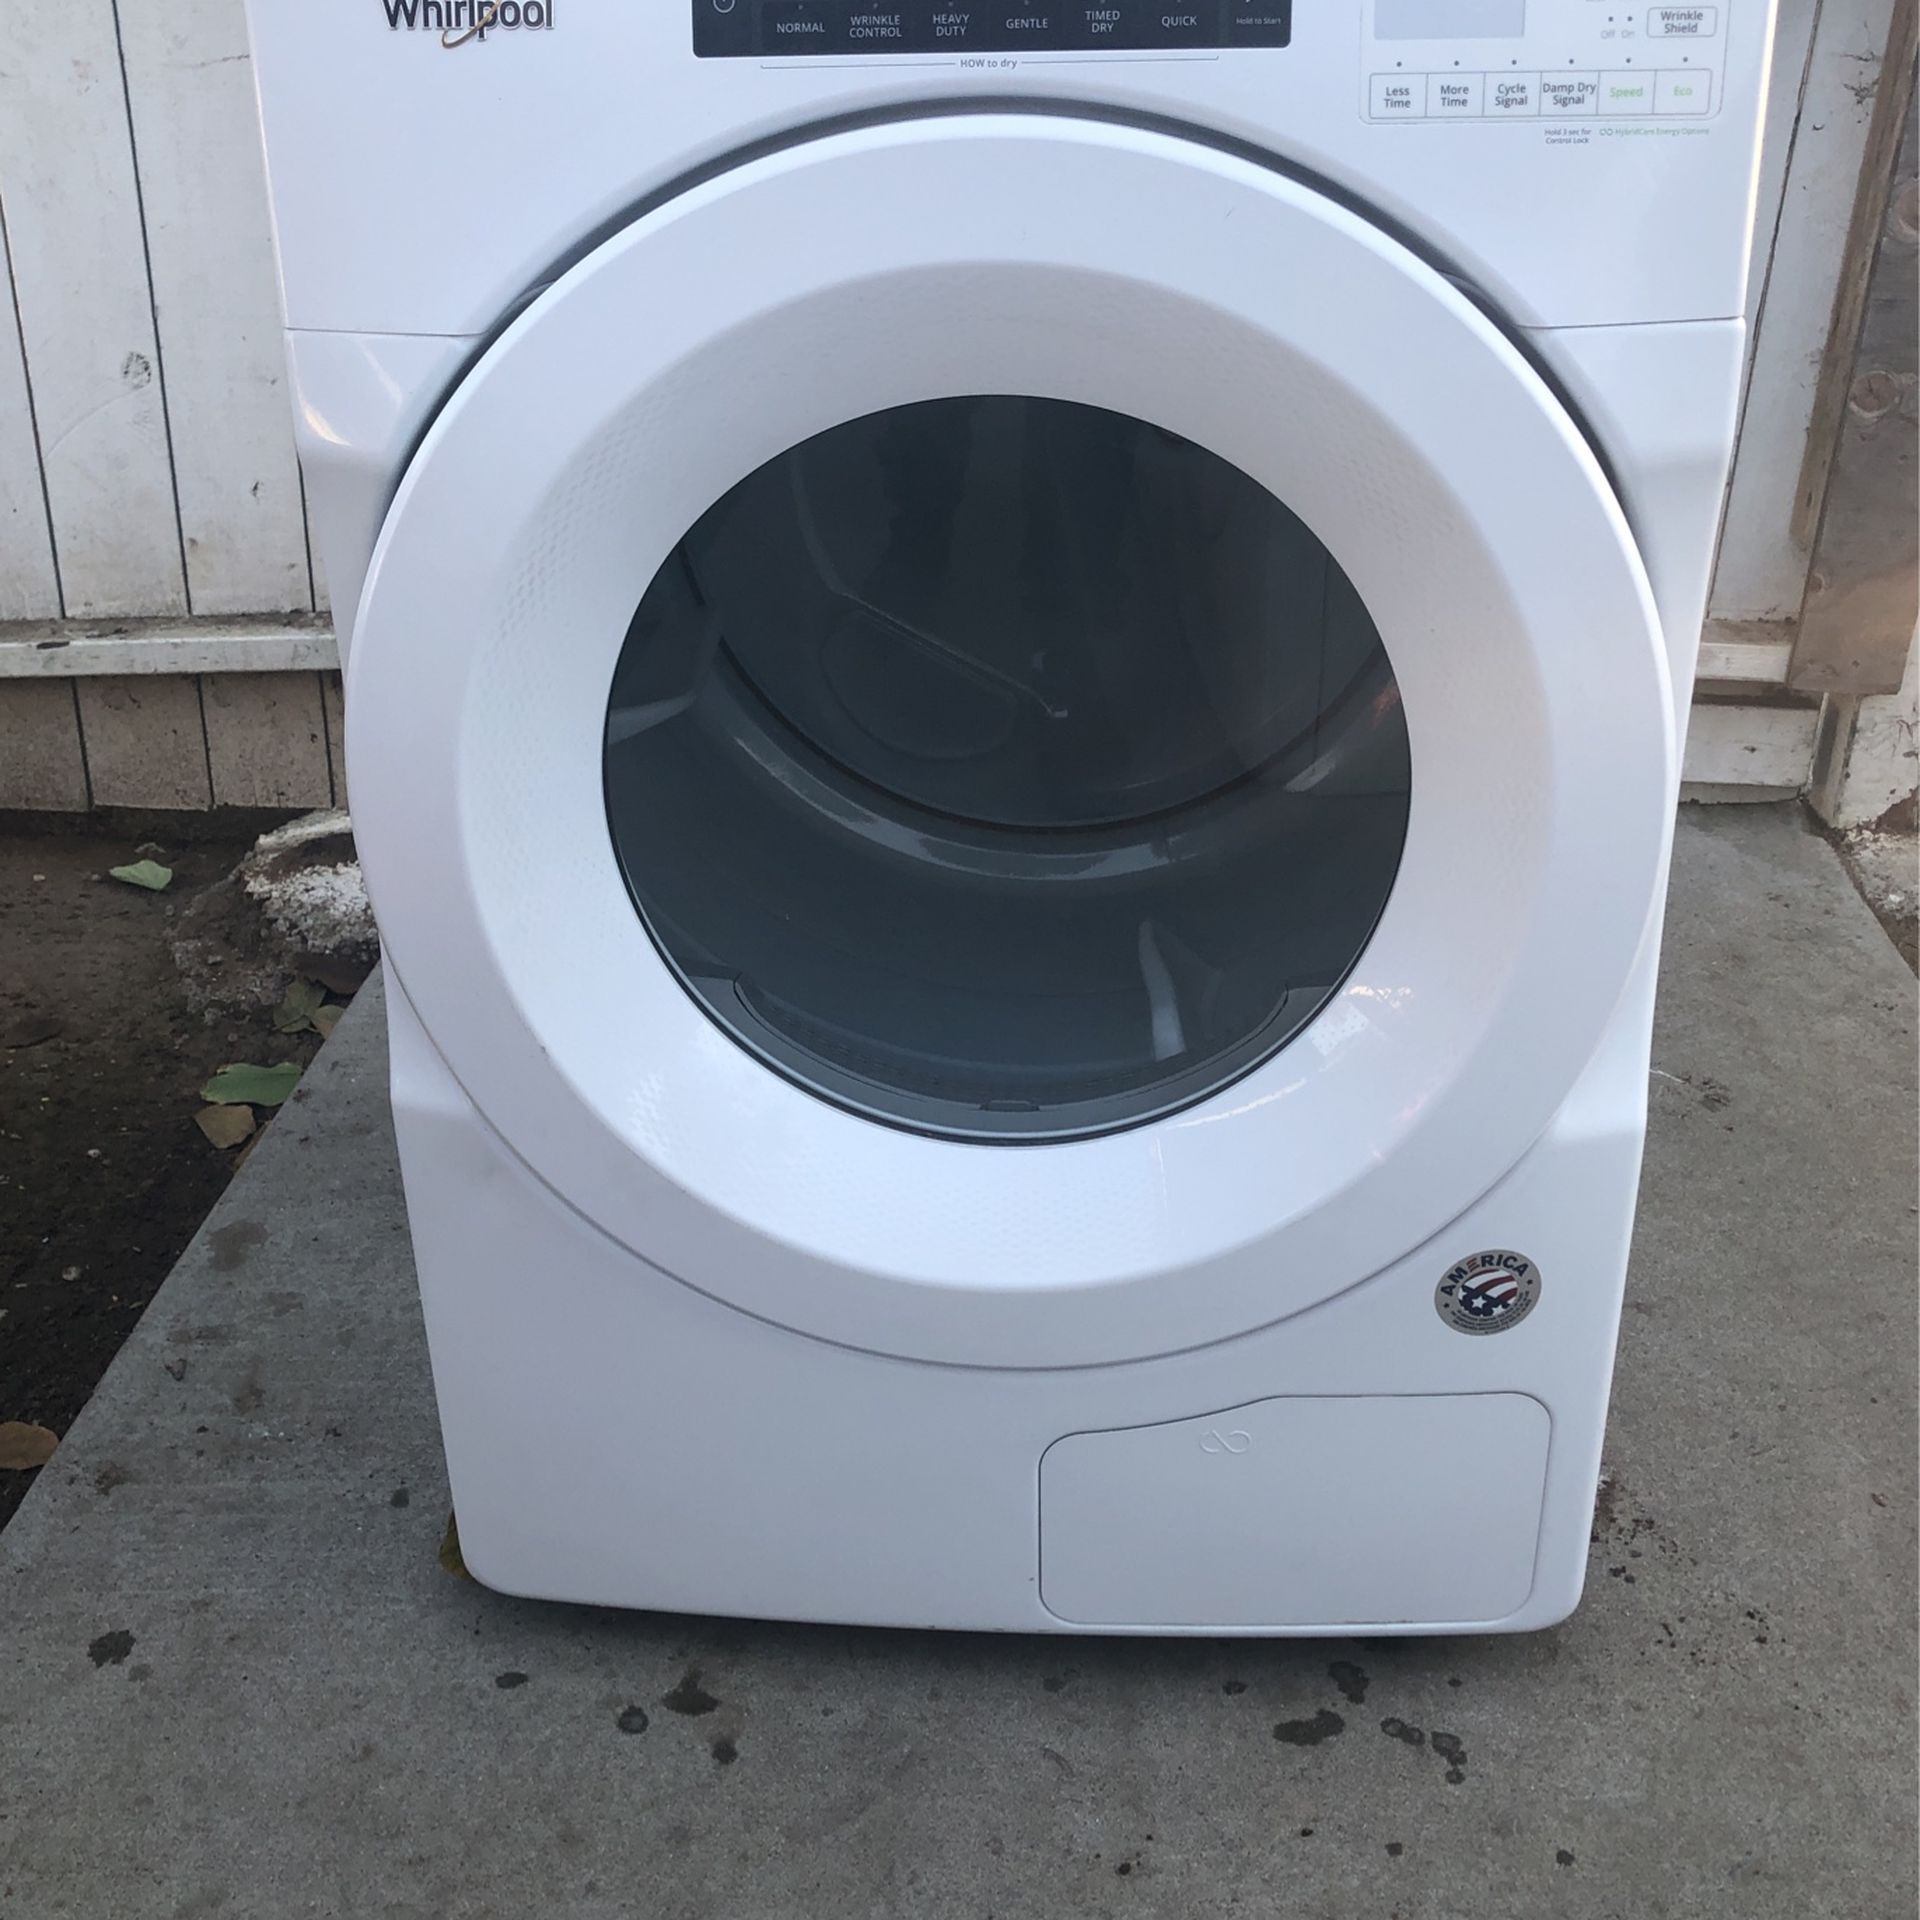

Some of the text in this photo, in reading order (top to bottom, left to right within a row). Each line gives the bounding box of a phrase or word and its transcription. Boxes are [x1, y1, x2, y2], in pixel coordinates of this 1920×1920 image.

[383, 0, 555, 41] Whirlpool
[850, 15, 901, 26] WRINKLE
[933, 14, 970, 25] HEAVY
[1085, 10, 1120, 21] TIMED
[1660, 10, 1703, 21] Wrinkle
[1006, 18, 1049, 29] GENTLE
[1161, 16, 1198, 27] QUICK
[776, 22, 825, 33] NORMAL
[850, 26, 902, 38] CONTROL
[936, 26, 967, 37] DUTY
[1091, 22, 1114, 33] DRY
[1664, 23, 1698, 34] Shield
[1600, 30, 1615, 39] Off
[1621, 30, 1635, 38] On
[960, 58, 1018, 70] HOW to dry
[1385, 86, 1410, 96] Less
[1440, 85, 1469, 95] More
[1497, 83, 1526, 96] Cycle
[1542, 82, 1597, 95] Damp Dry
[1609, 87, 1643, 98] Speed
[1673, 85, 1693, 96] Eco
[1384, 98, 1411, 108] Time
[1441, 97, 1468, 107] Time
[1495, 96, 1528, 108] Signal
[1553, 95, 1585, 107] Signal
[1545, 128, 1562, 136] Hold
[1582, 128, 1591, 136] for
[1656, 128, 1680, 136] Energy
[1440, 1254, 1528, 1297] AMERICA
